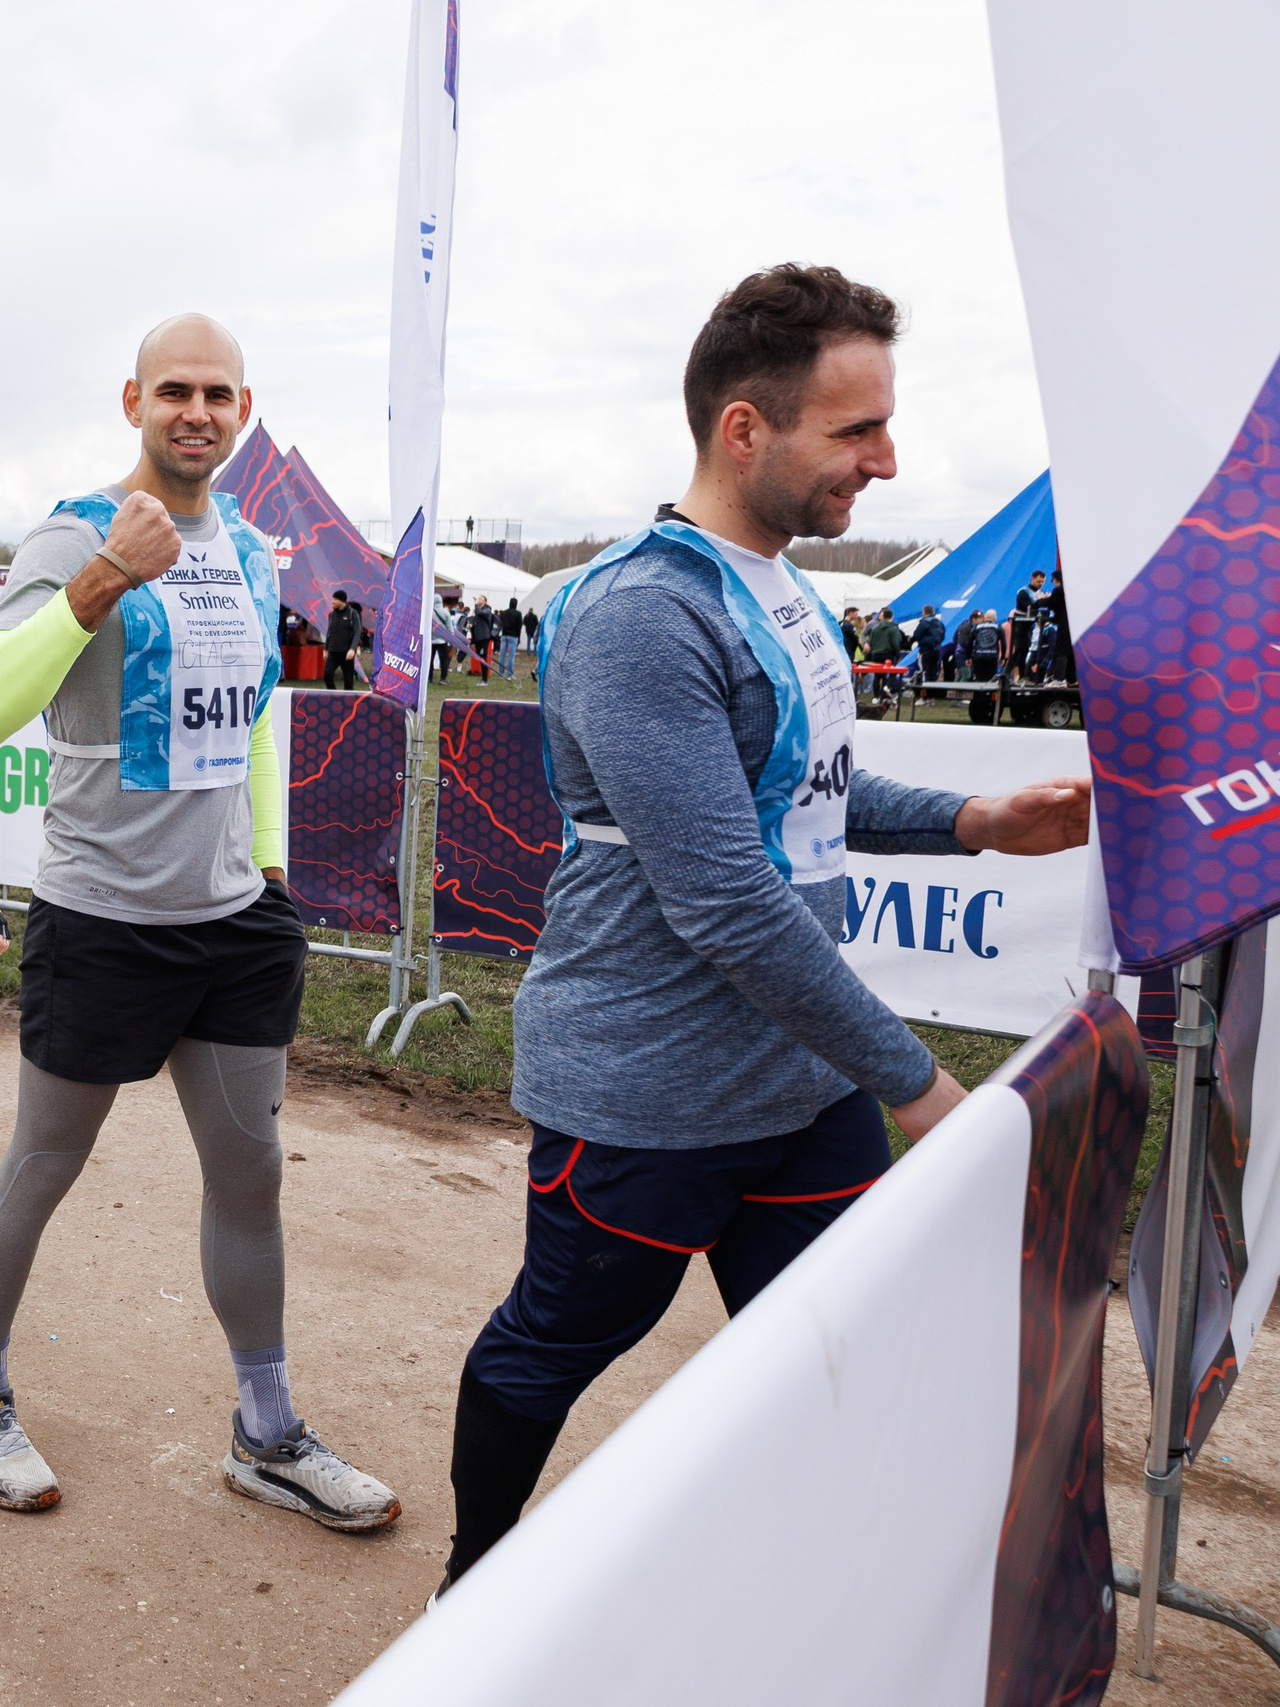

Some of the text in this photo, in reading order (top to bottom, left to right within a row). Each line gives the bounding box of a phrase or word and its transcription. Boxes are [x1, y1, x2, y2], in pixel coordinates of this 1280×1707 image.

[201, 568, 241, 581] ГЕРОЕВ
[179, 591, 239, 610] Sminex
[187, 619, 245, 627] ПЕРФЕКЦИОНИСТЫ
[204, 629, 247, 637] DEVELOPMENT
[183, 685, 257, 730] 5410
[89, 886, 117, 896] DRI-FIT
